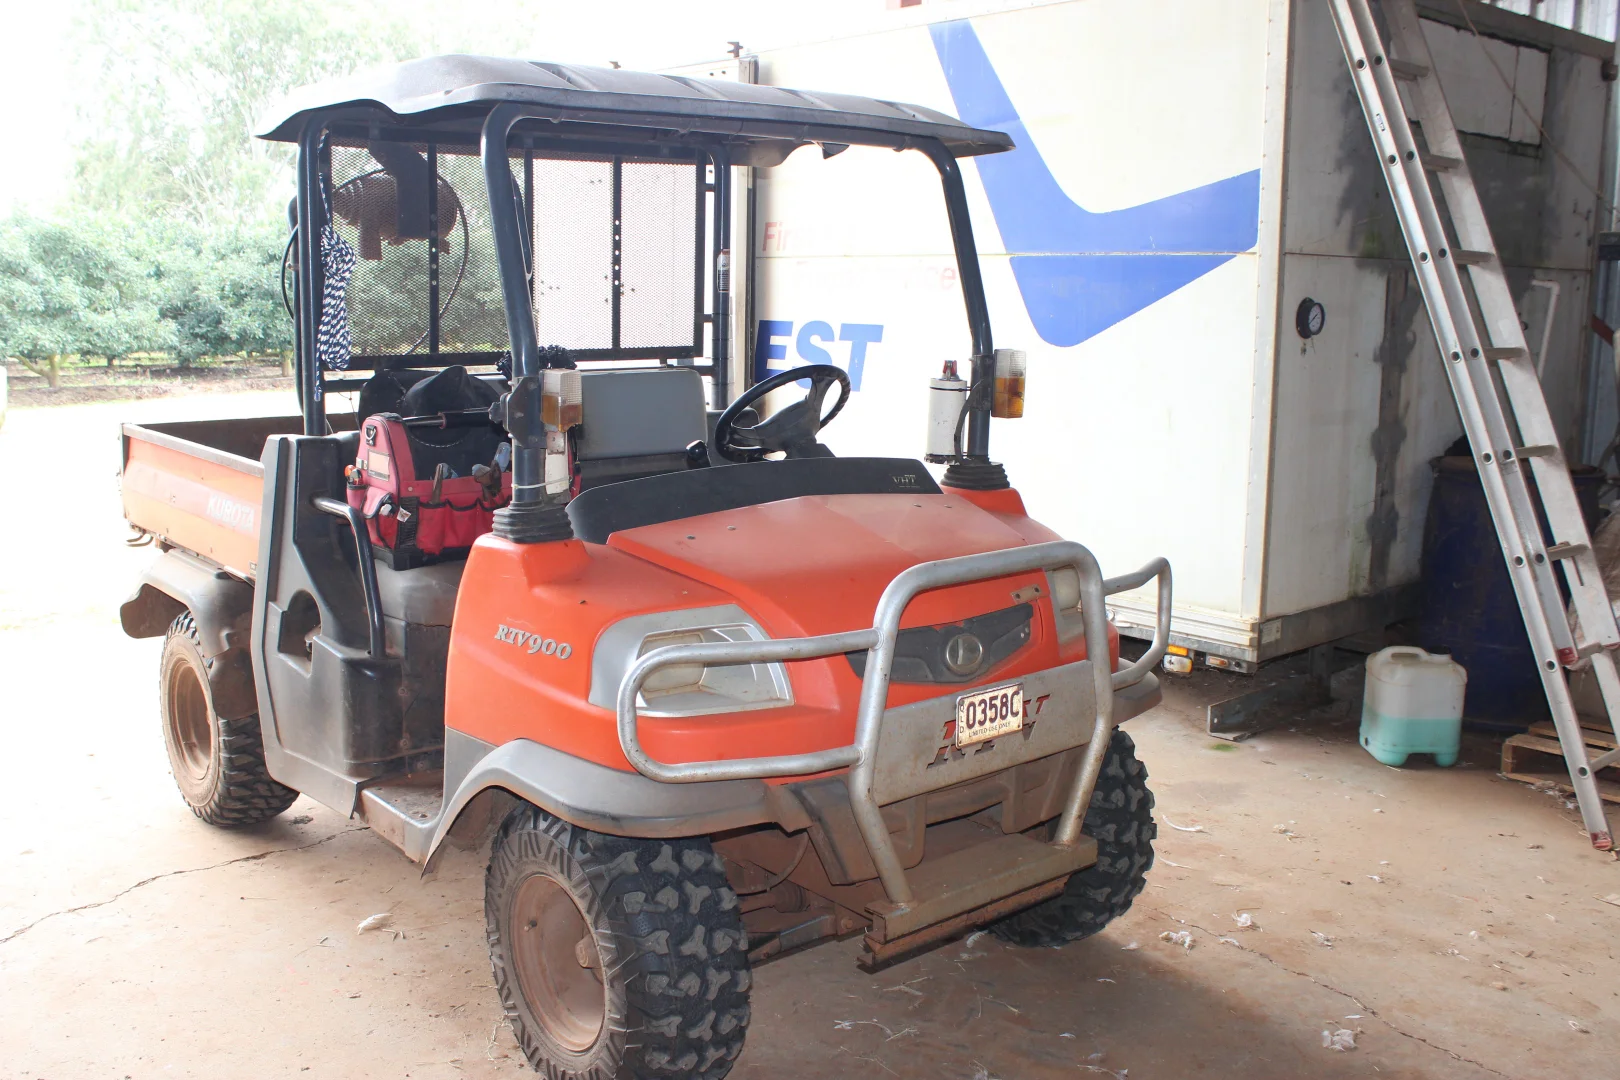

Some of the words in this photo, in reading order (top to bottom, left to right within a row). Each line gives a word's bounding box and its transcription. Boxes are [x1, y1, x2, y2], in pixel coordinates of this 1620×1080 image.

[206, 493, 256, 533] KUBOTA
[494, 623, 573, 660] RTV900
[966, 690, 1021, 730] 0358C
[968, 727, 988, 738] LIMITED
